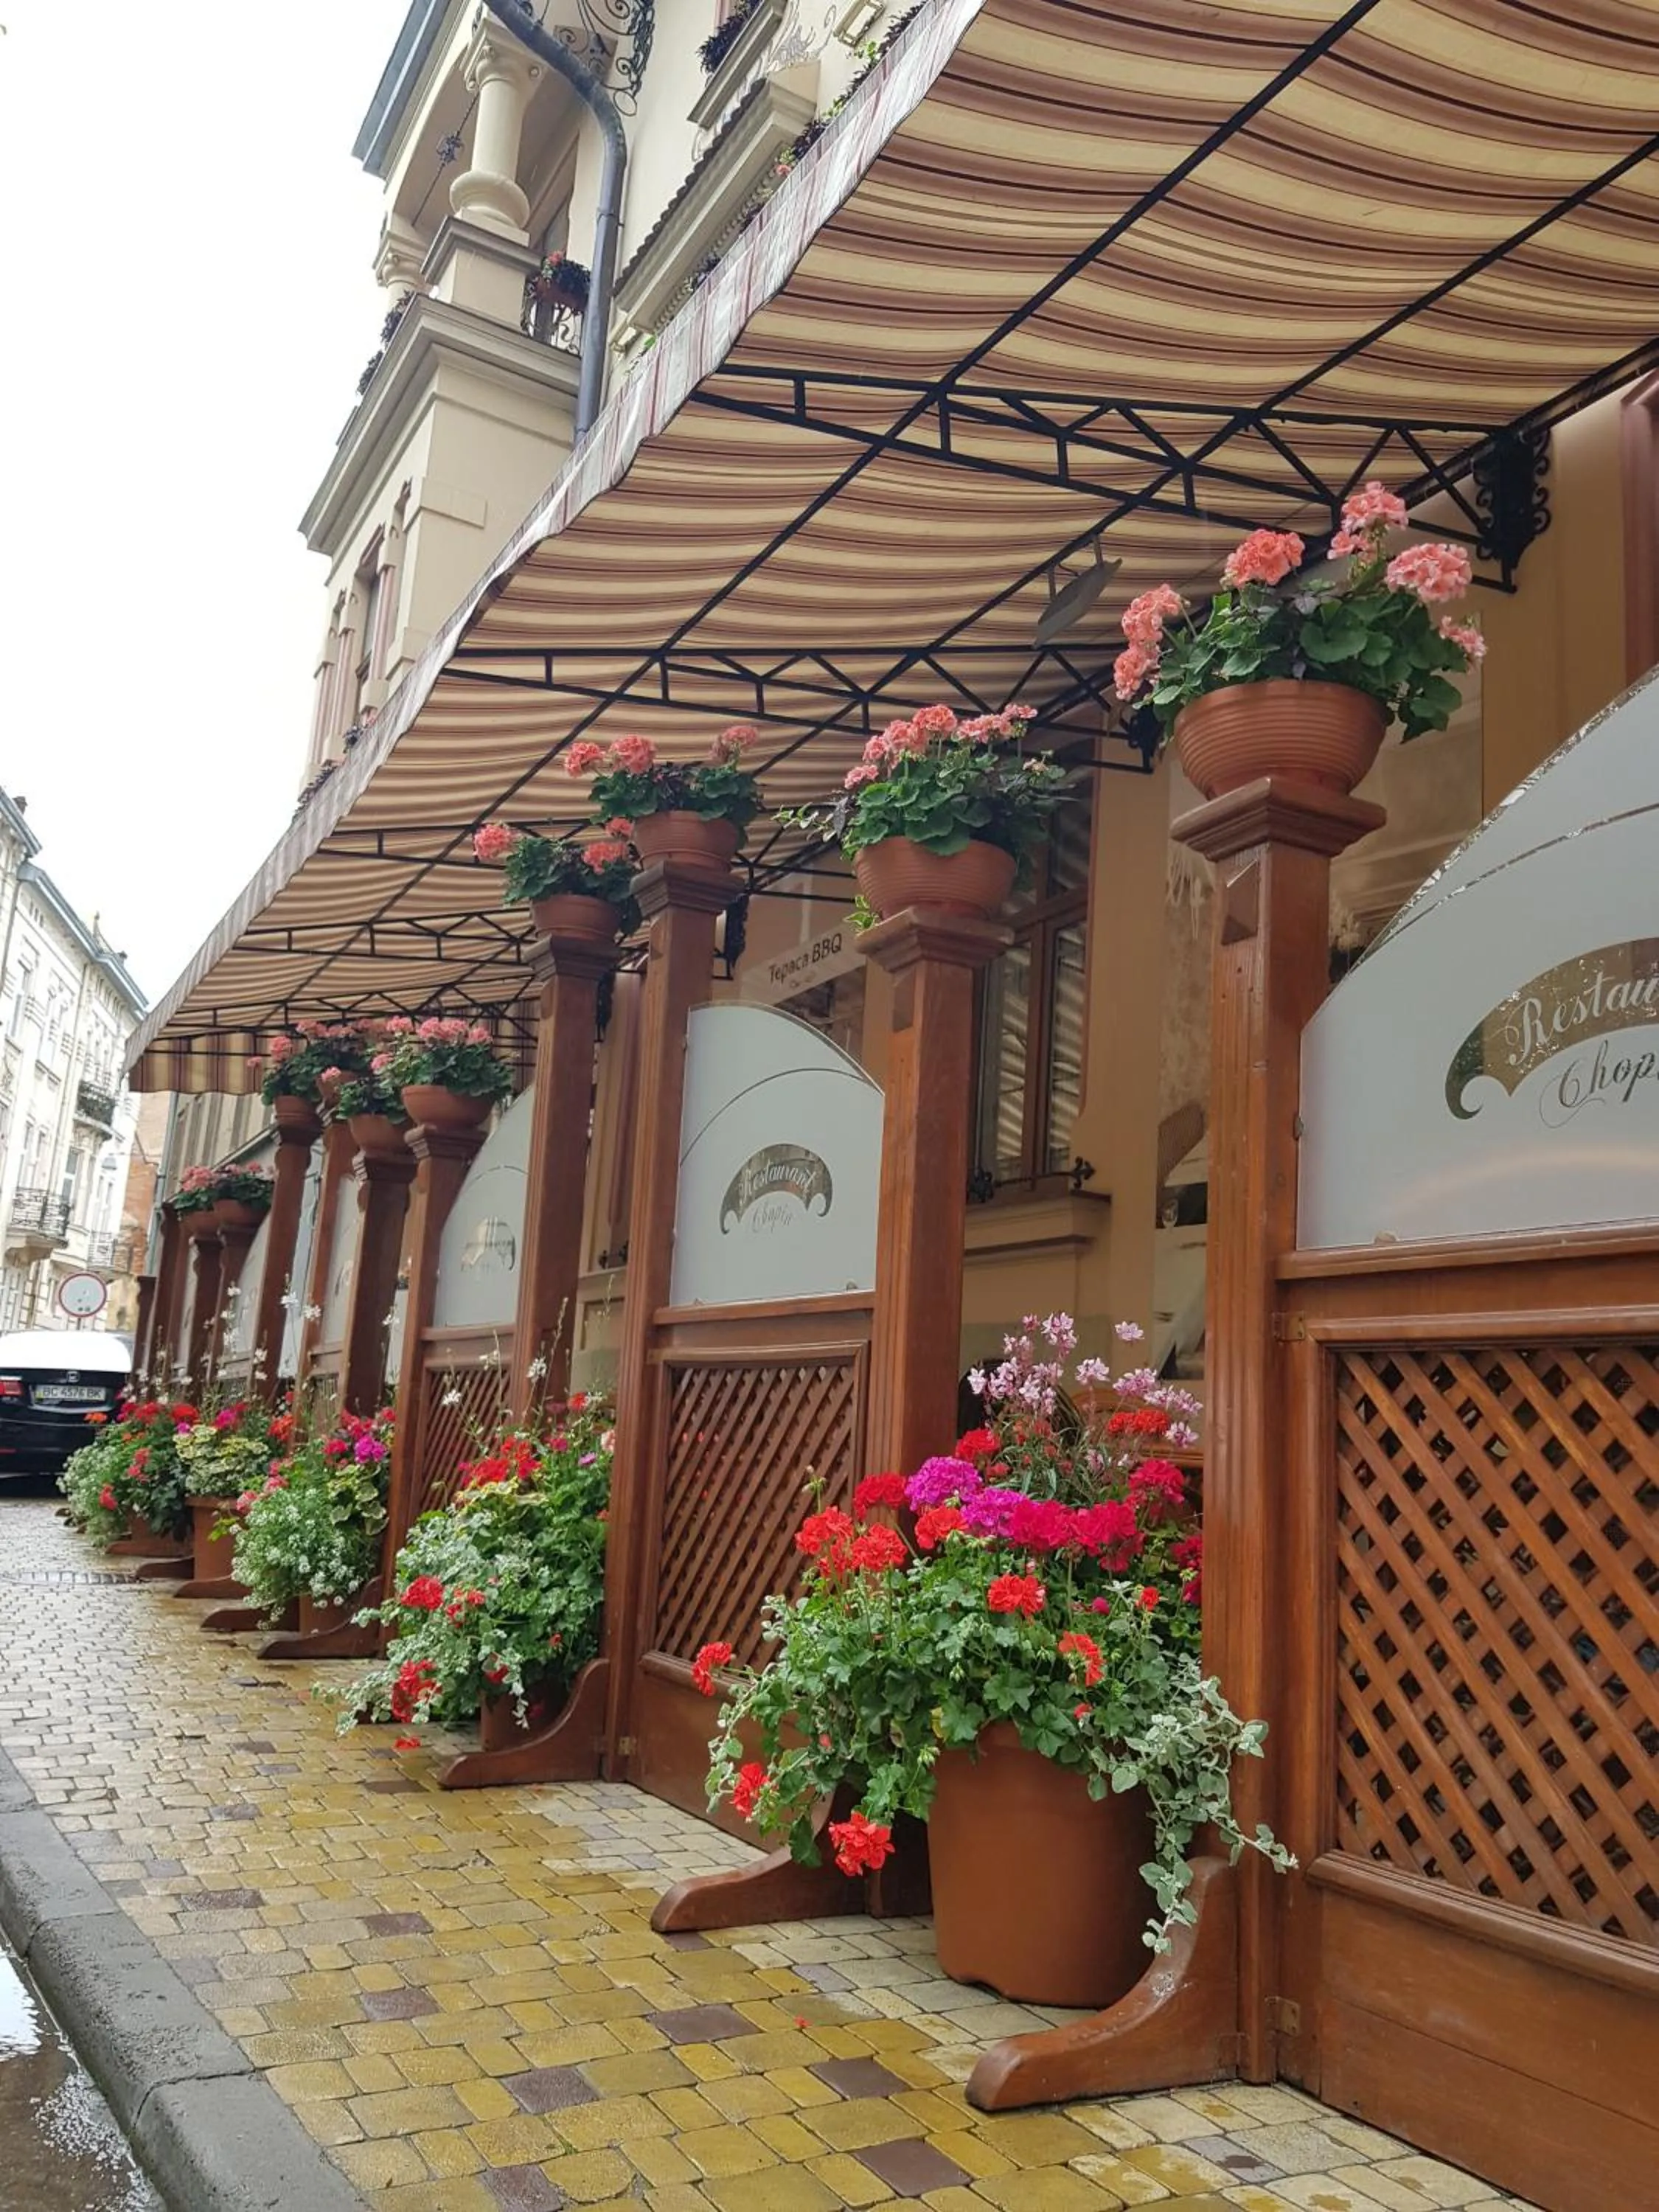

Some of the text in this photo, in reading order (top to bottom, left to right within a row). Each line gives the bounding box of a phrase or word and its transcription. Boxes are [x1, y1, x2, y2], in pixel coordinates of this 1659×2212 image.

[812, 933, 842, 963] BBQ
[1540, 1040, 1659, 1128] Chop
[44, 1387, 58, 1397] BC
